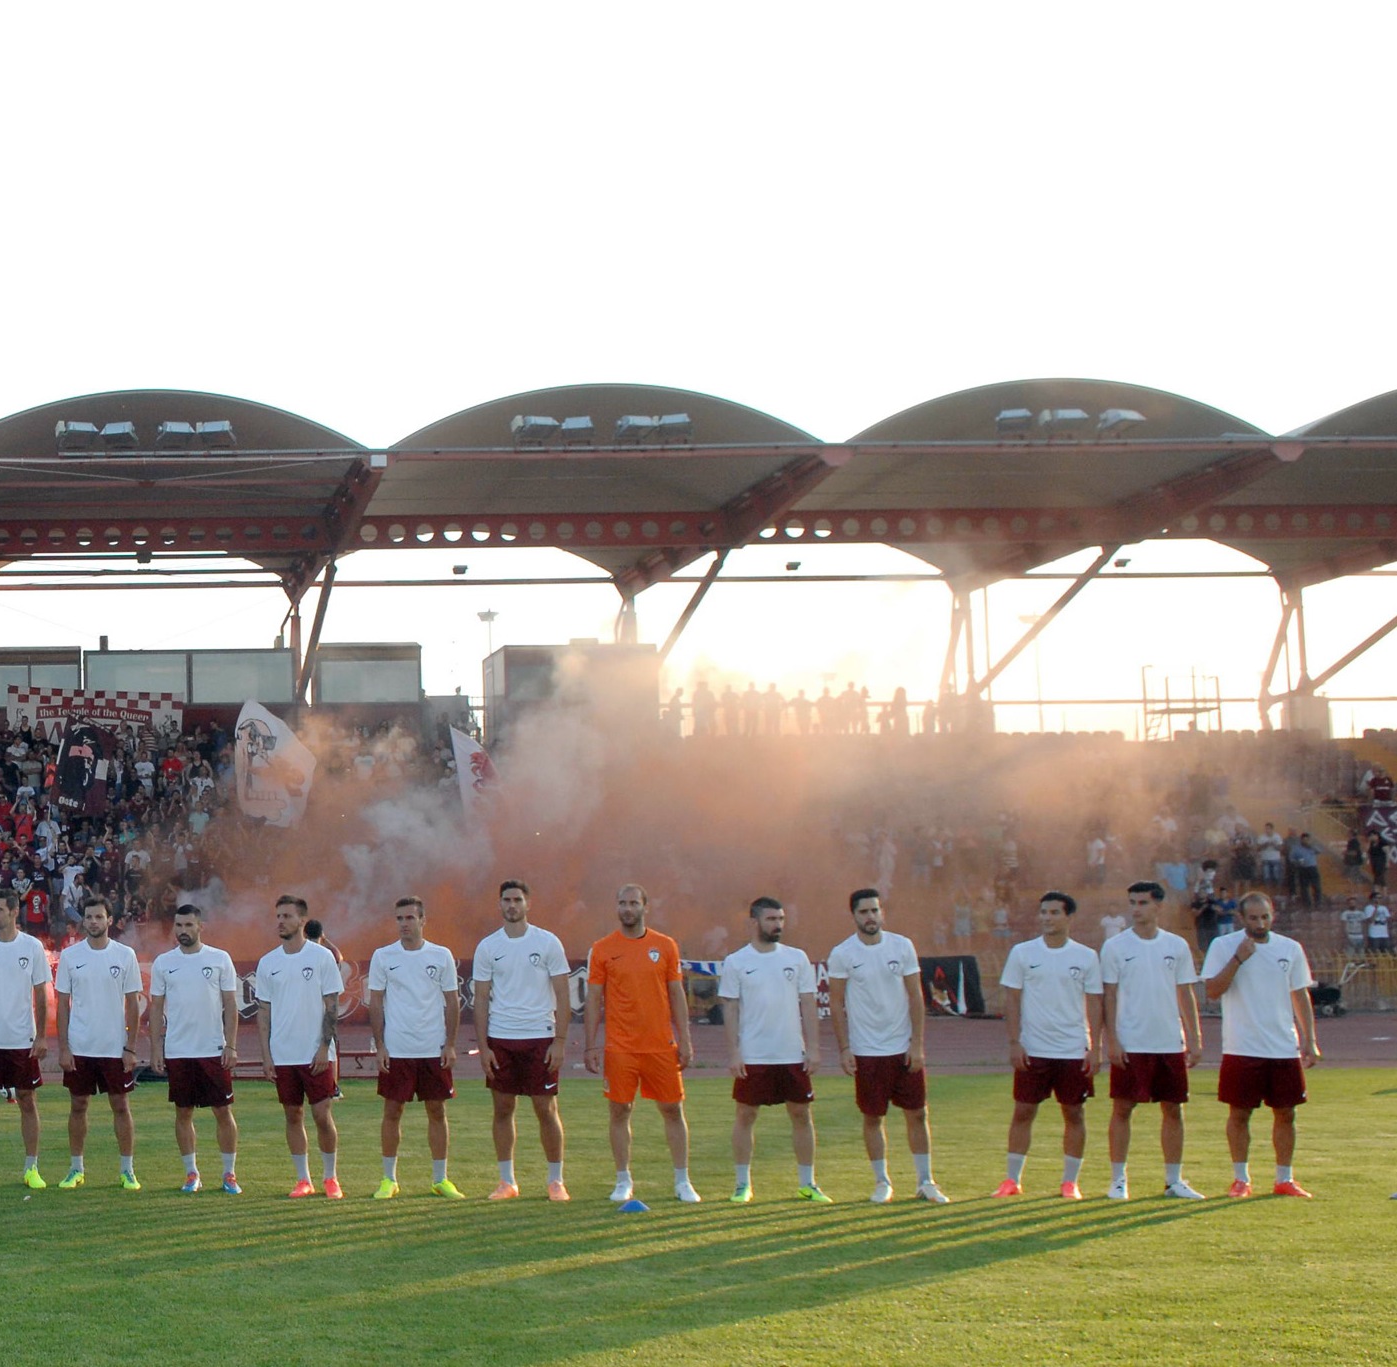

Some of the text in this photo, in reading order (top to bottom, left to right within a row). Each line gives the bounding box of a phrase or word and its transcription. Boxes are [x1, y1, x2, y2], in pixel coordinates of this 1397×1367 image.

[39, 708, 55, 717] the
[91, 708, 101, 716] of
[103, 708, 118, 718] the
[120, 709, 149, 721] Queen
